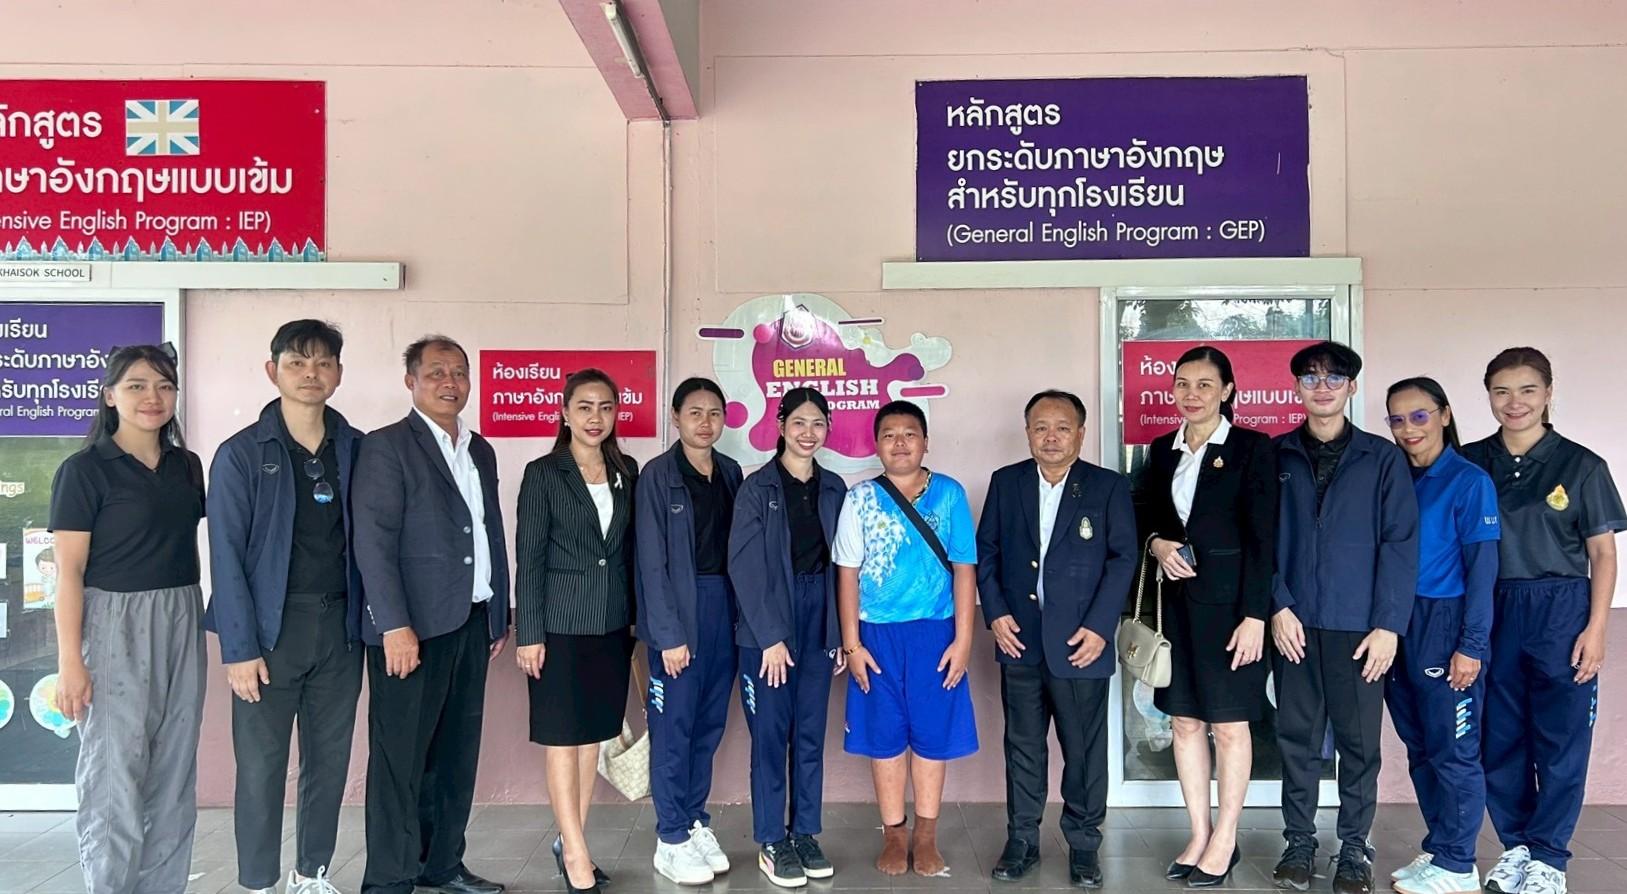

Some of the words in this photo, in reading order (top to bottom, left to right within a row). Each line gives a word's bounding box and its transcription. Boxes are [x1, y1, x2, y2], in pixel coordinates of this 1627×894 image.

[946, 97, 1061, 136] หลักสูตร
[947, 138, 1225, 175] ยกระดับภาษาอังกฤษ
[0, 156, 293, 202] ษาอังกฤษแบบเข้ม
[947, 176, 1184, 217] สำหรับทุกโรงเรียน
[0, 210, 52, 230] nsive
[60, 208, 127, 236] English
[135, 211, 218, 236] Program
[225, 216, 231, 231] :
[239, 211, 271, 233] IEP)
[946, 220, 1034, 247] (General
[1041, 219, 1109, 248] English
[1116, 221, 1199, 247] Program
[1206, 225, 1212, 240] :
[1219, 219, 1266, 243] GEP)
[44, 268, 85, 278] SCHOOL
[0, 317, 48, 338] เรียน
[492, 361, 561, 379] ห้องเรียน
[773, 357, 847, 378] GENERAL
[17, 404, 54, 421] English
[827, 400, 880, 411] OGRAM
[492, 411, 535, 422] (Intensive
[538, 411, 560, 424] Engli
[1140, 413, 1186, 426] (Intensiv
[1233, 413, 1278, 427] Program
